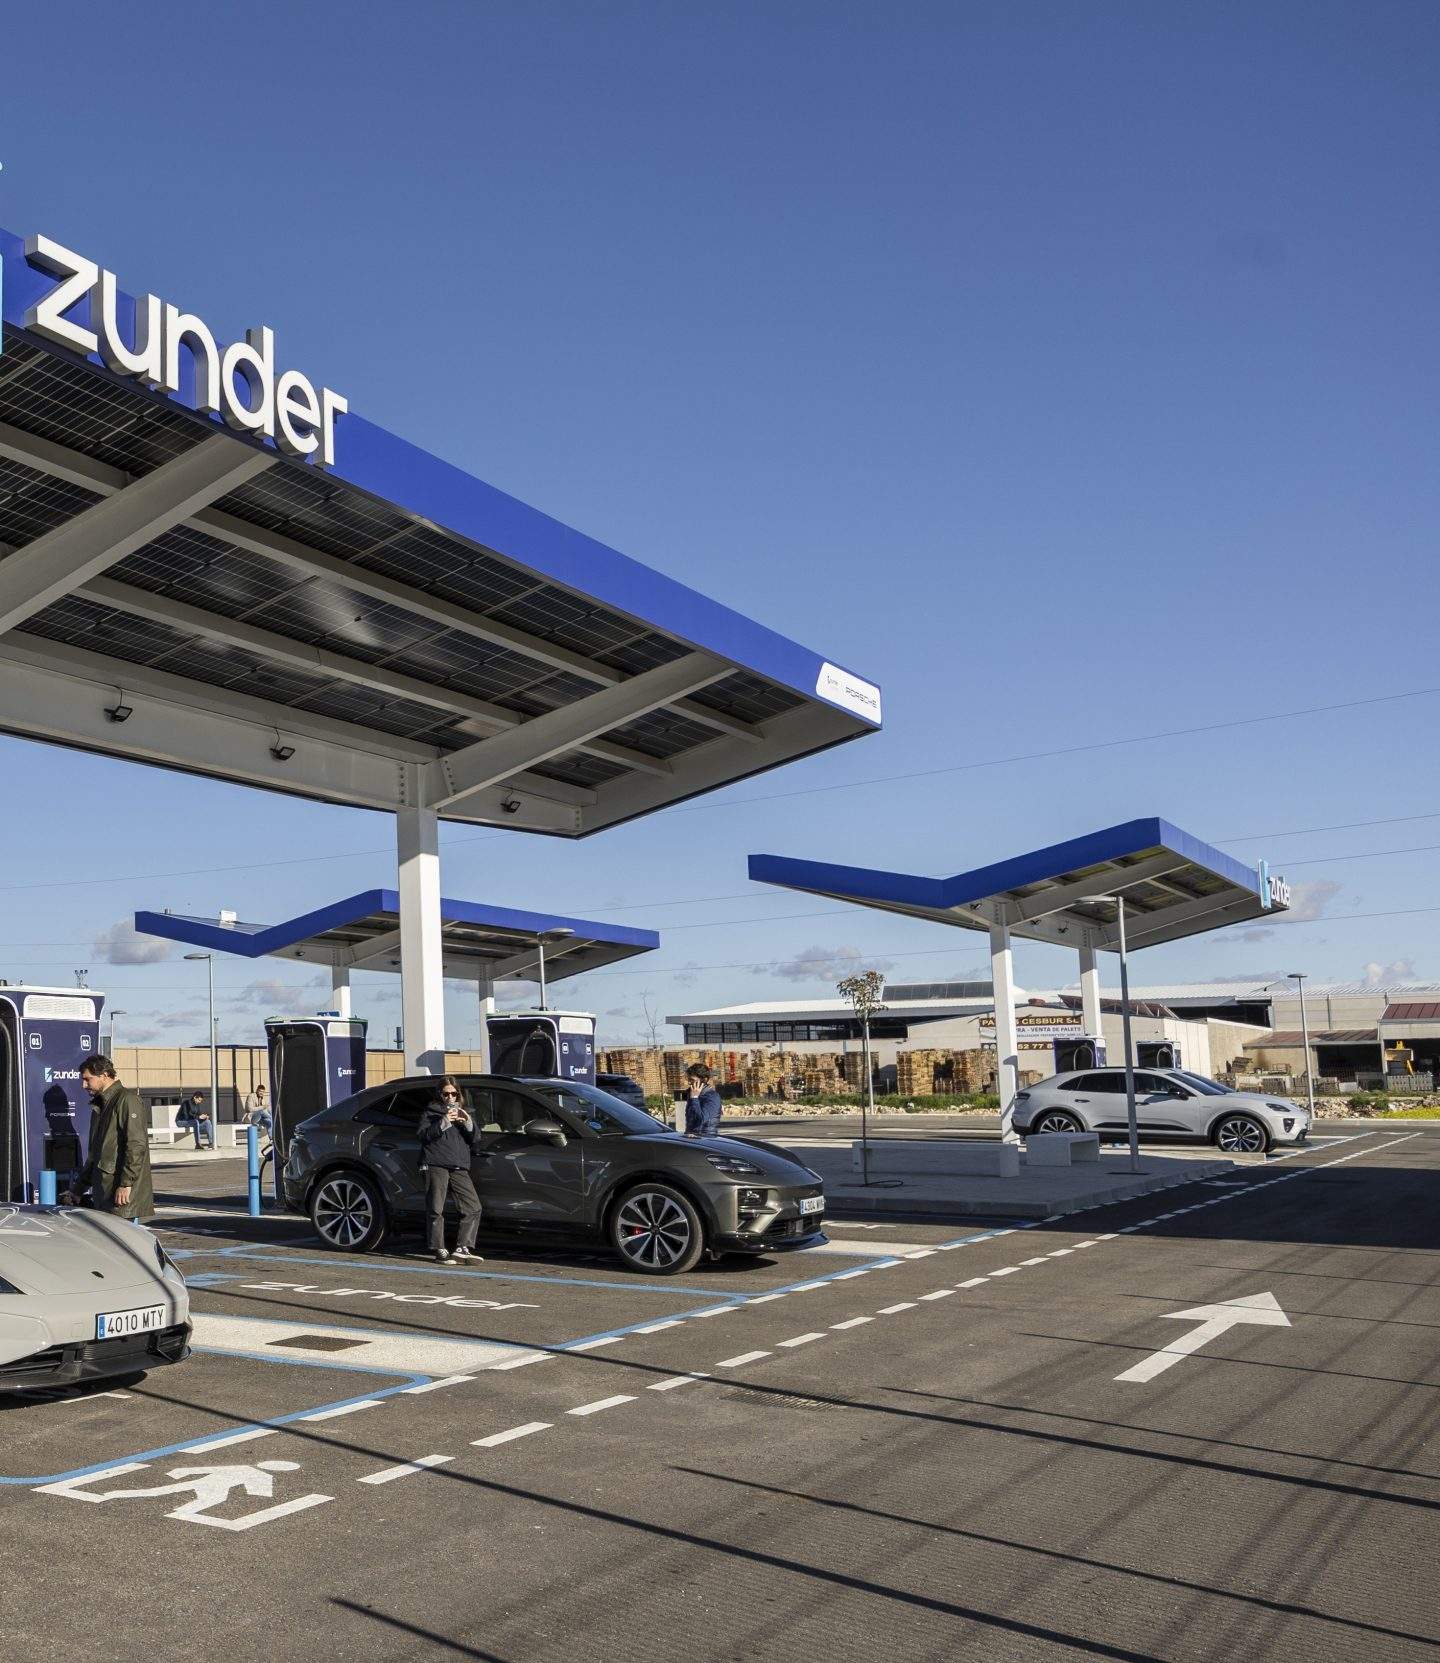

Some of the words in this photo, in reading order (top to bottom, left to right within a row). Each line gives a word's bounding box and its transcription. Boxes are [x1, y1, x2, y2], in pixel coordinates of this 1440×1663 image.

[26, 233, 349, 467] zunder
[31, 1037, 40, 1046] 01
[53, 1069, 81, 1080] zunder
[239, 1281, 541, 1311] zunder
[107, 1314, 138, 1334] 4010
[142, 1308, 164, 1329] MTY
